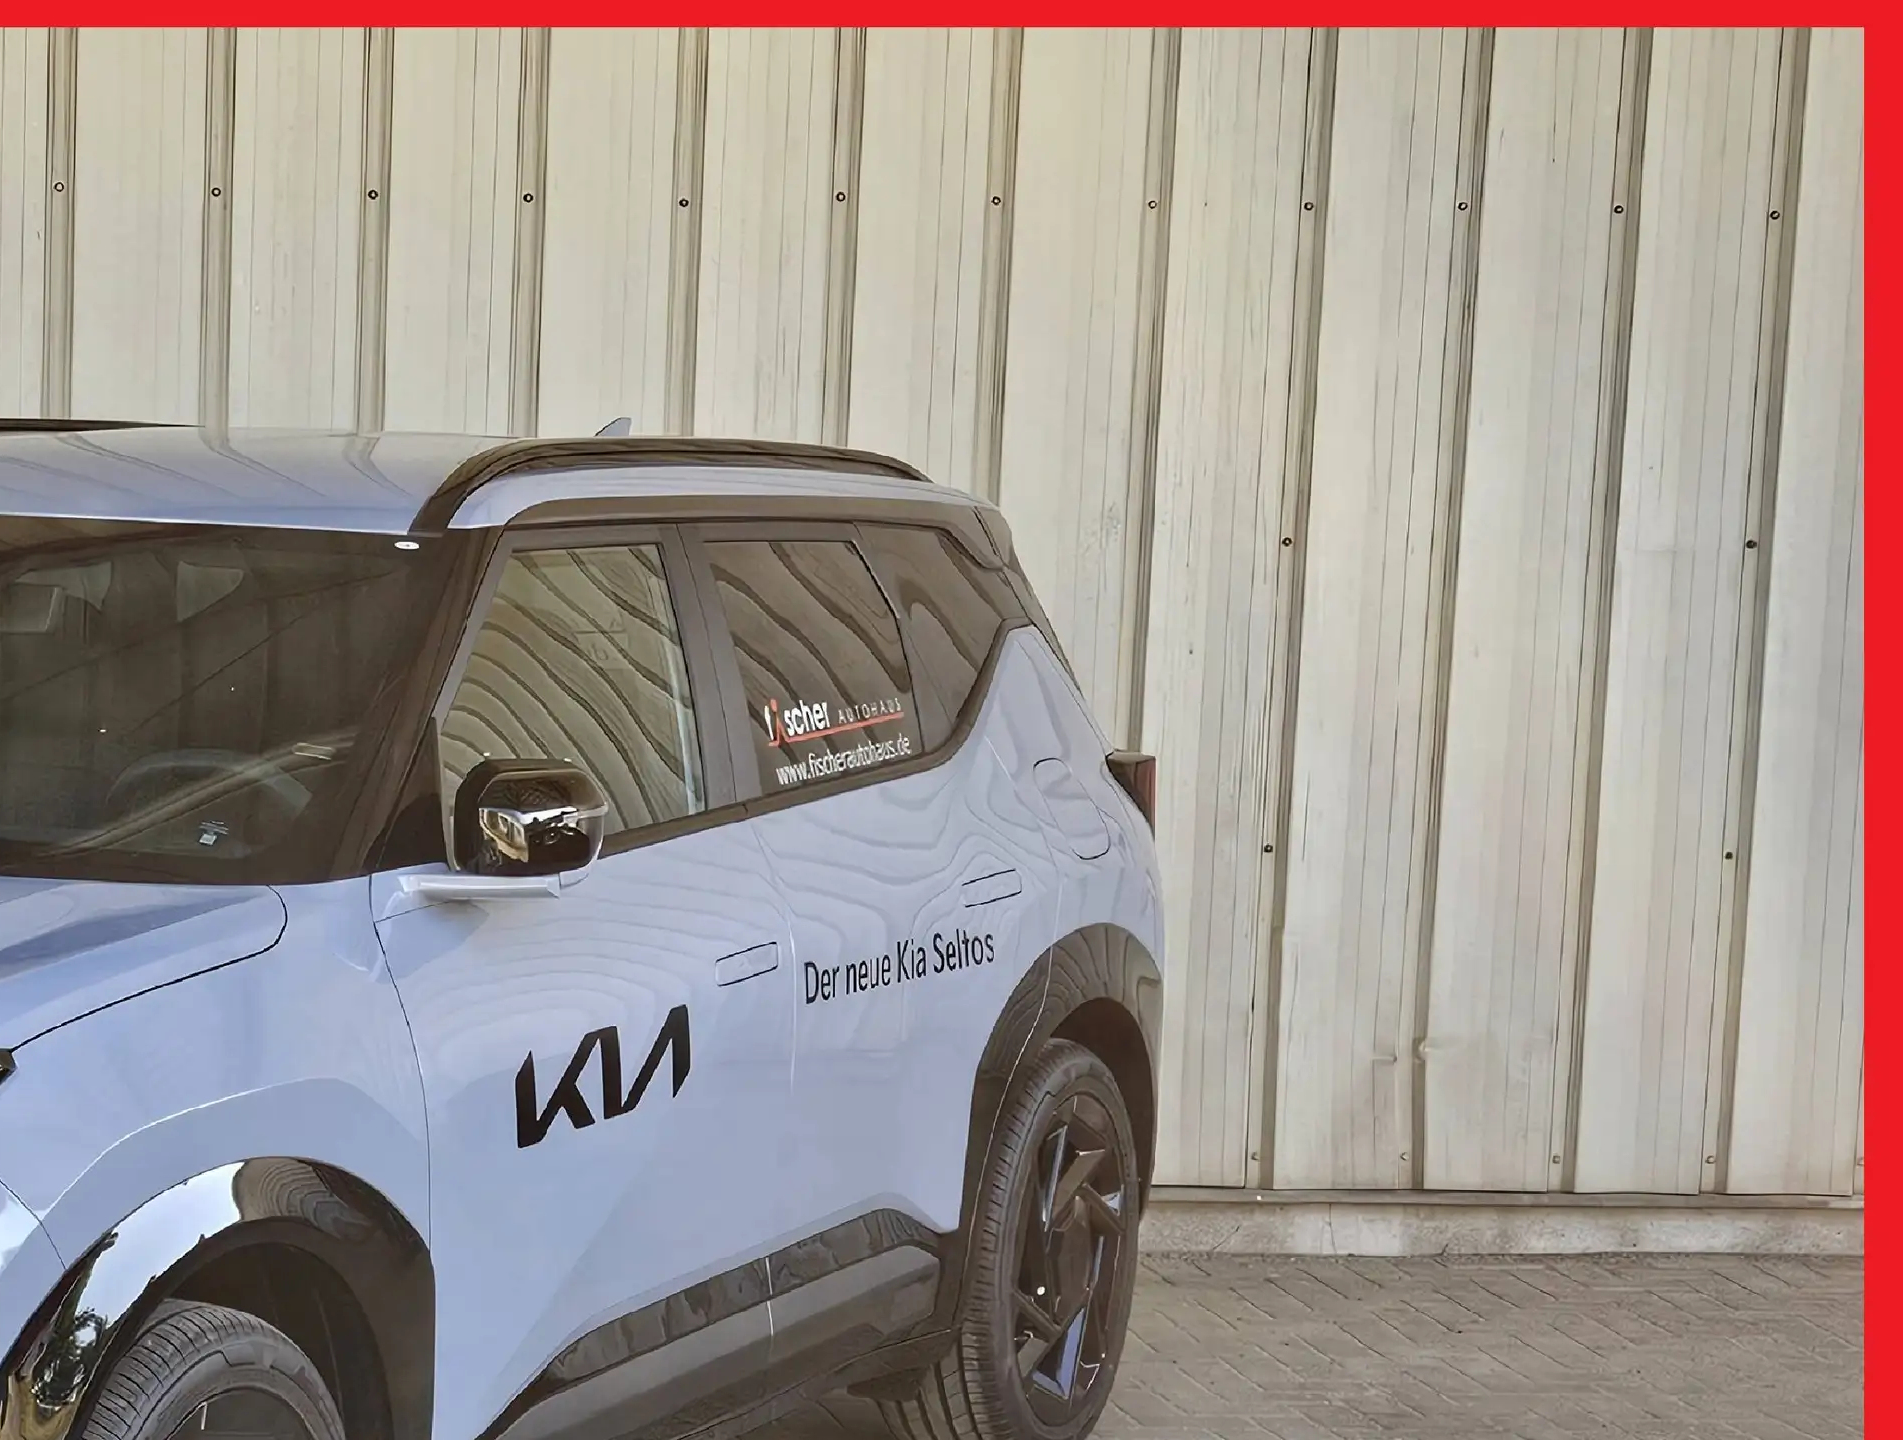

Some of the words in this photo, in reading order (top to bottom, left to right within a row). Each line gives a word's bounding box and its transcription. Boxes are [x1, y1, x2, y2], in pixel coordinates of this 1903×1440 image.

[764, 698, 831, 741] fischer
[838, 698, 901, 724] AUTOHAUS
[776, 732, 912, 785] www.fischerautohaus.de
[804, 961, 839, 1004] Der
[846, 954, 891, 995] neue
[897, 938, 927, 983] Kia
[933, 928, 995, 974] Seltos
[515, 1004, 691, 1148] KIA
